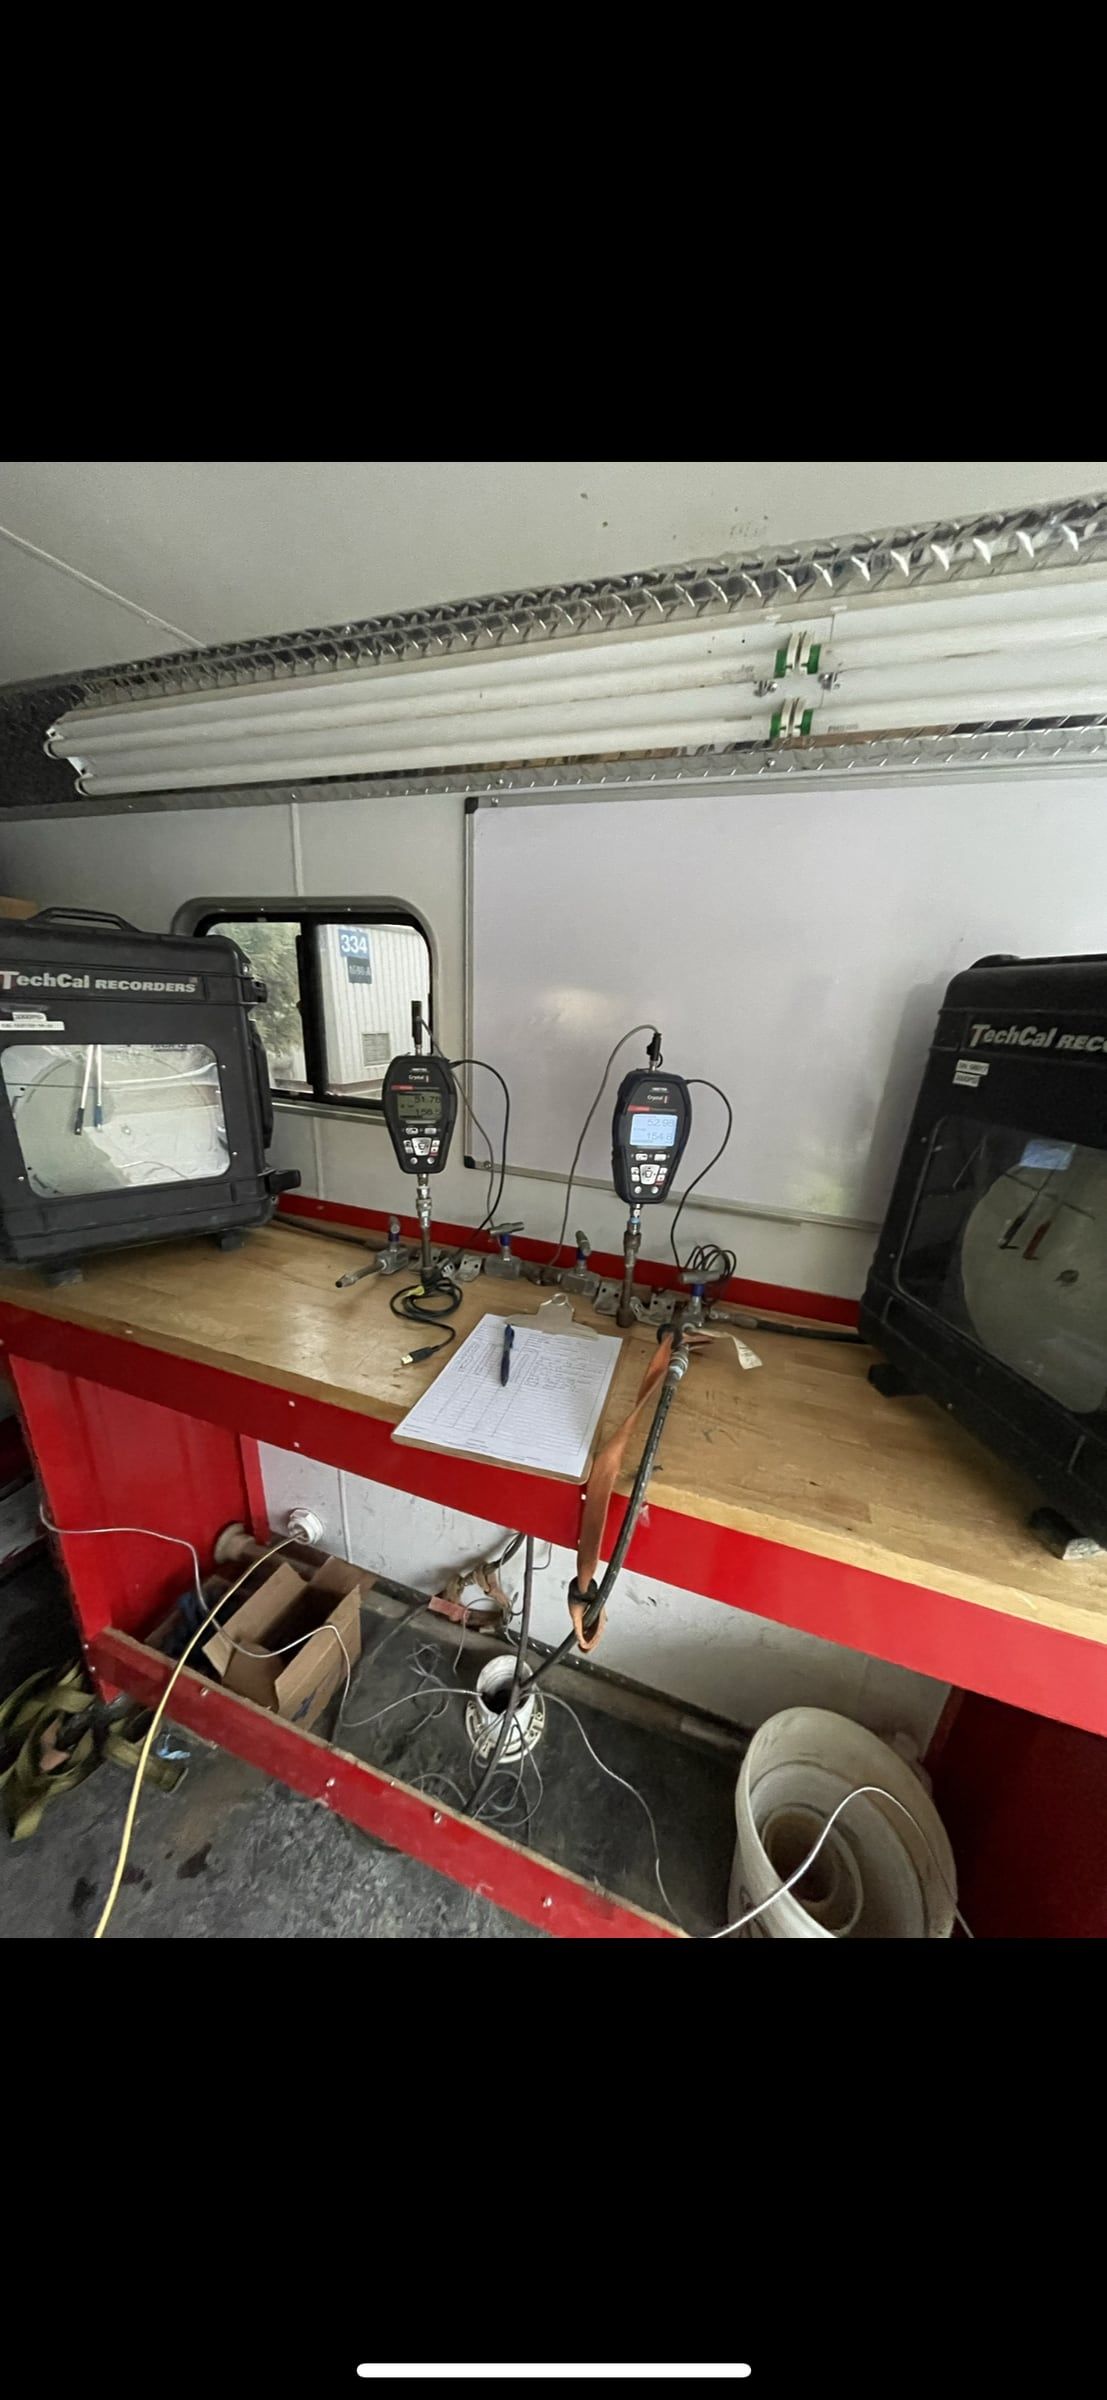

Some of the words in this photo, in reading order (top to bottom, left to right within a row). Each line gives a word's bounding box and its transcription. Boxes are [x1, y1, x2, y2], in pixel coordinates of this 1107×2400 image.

[341, 934, 367, 954] 334
[0, 971, 90, 990] TechCal
[95, 979, 196, 993] RECORDERS
[969, 1023, 1058, 1049] TechCal
